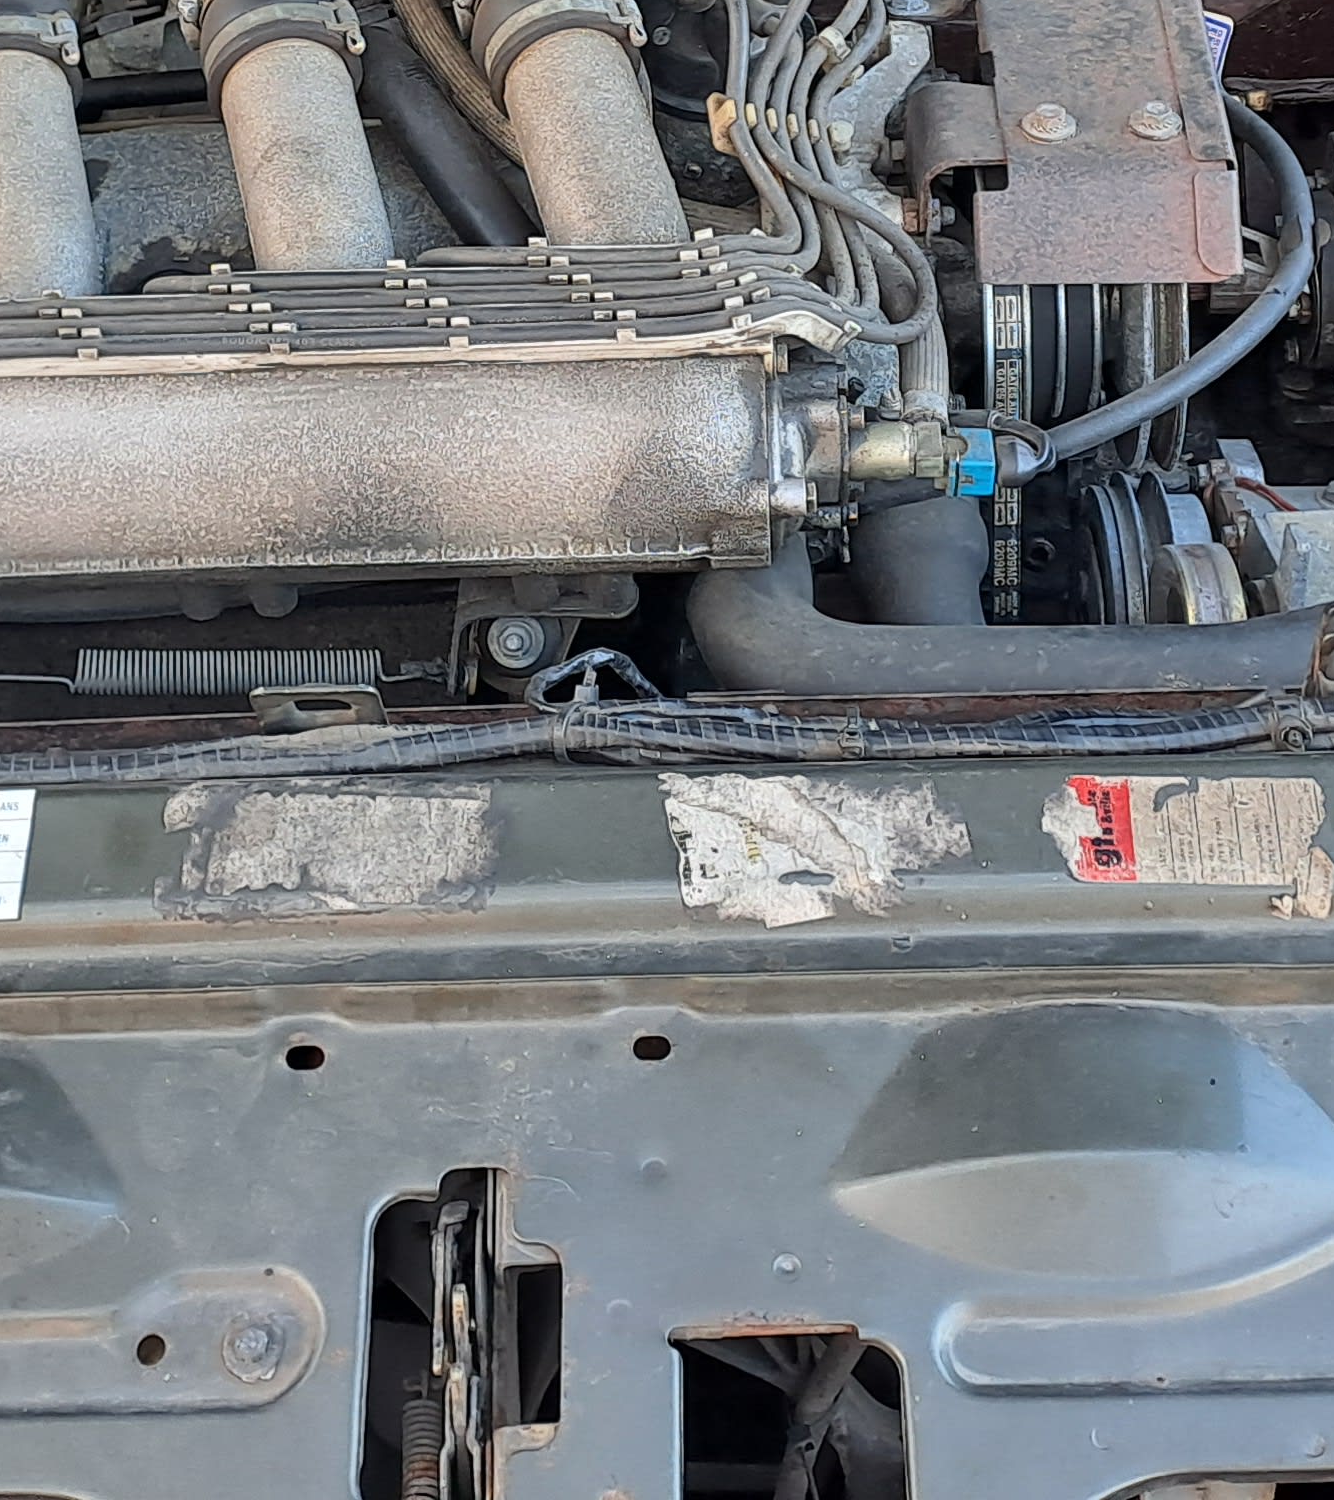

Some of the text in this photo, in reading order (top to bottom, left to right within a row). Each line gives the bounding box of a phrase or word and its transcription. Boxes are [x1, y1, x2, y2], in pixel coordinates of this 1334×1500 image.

[994, 540, 1006, 587] 6209MC
[1006, 539, 1018, 586] 6209MC
[0, 801, 20, 812] ANS
